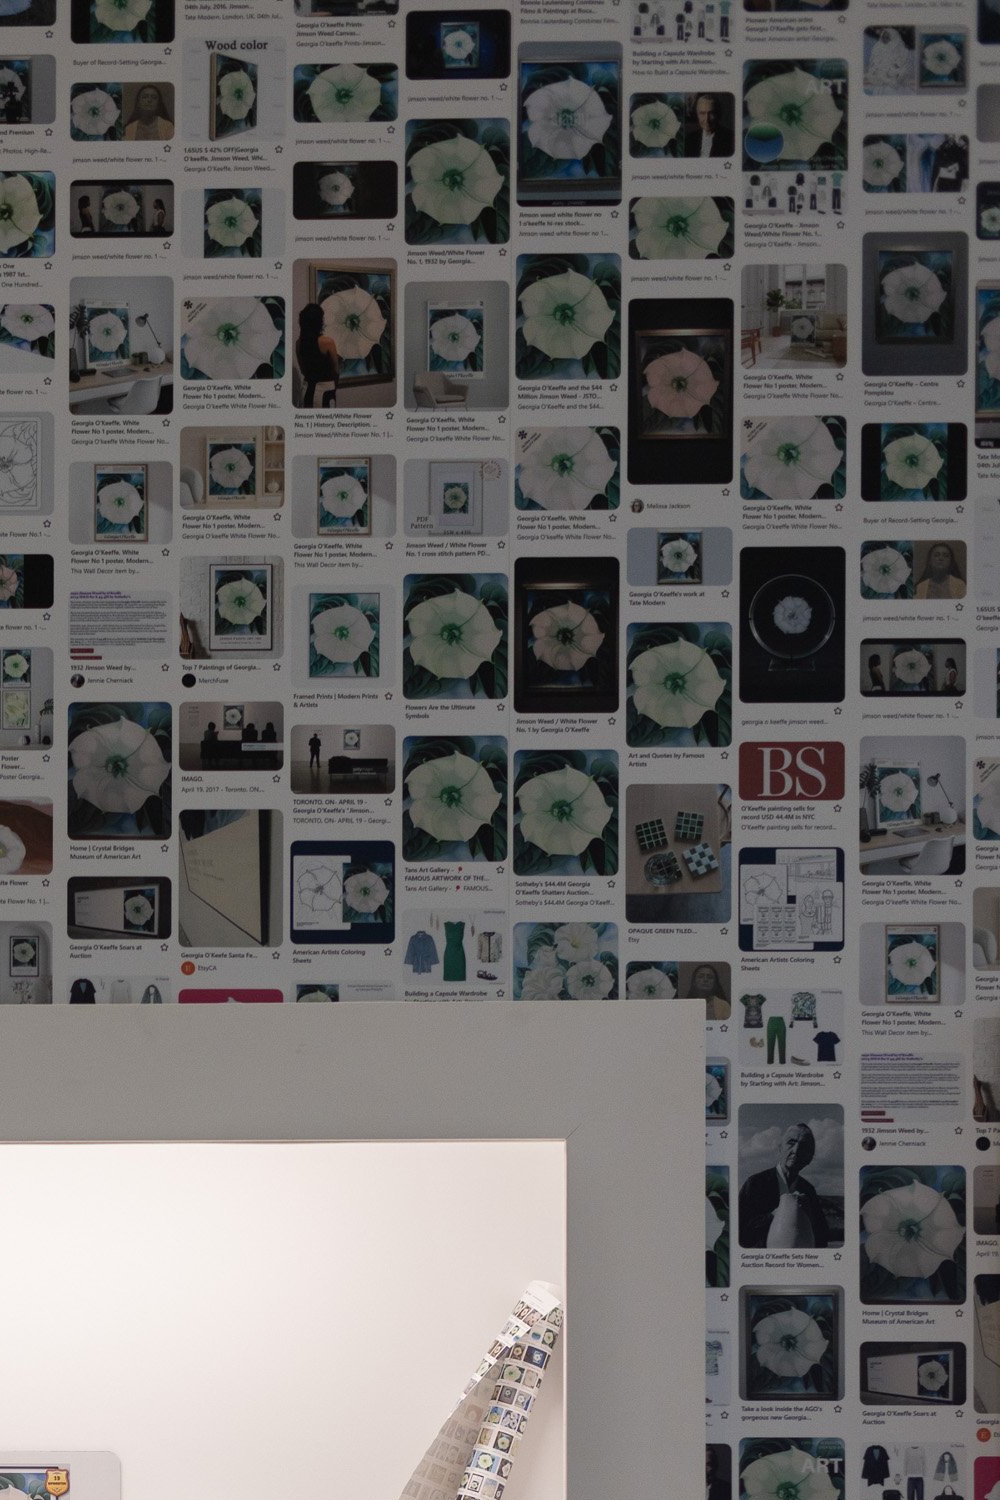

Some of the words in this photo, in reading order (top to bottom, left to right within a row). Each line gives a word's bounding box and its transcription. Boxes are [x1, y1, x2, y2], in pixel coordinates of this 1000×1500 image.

[205, 40, 237, 50] Wood
[240, 40, 268, 50] color
[758, 746, 826, 797] BS
[801, 1458, 844, 1474] ART
